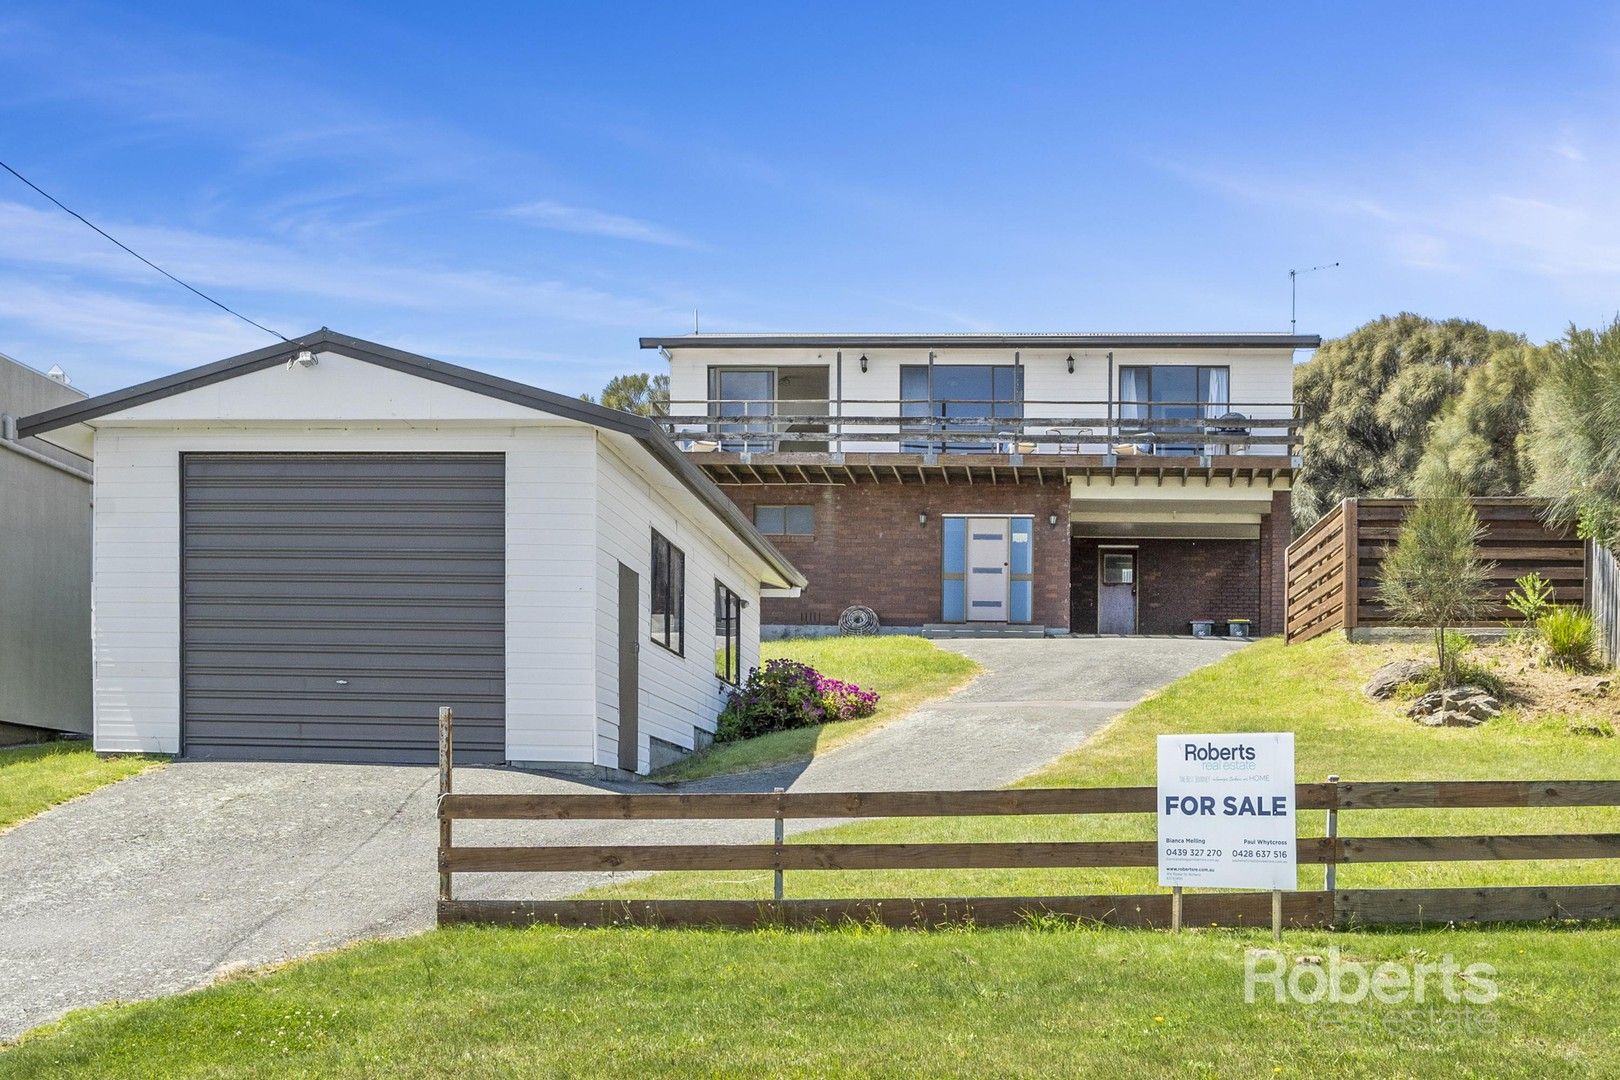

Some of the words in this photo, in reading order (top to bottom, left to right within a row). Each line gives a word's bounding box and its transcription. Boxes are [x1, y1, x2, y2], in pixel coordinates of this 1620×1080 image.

[1184, 742, 1256, 761] Roberts
[1202, 760, 1220, 771] real
[1222, 760, 1257, 771] estate
[1165, 796, 1216, 816] FOR
[1223, 796, 1287, 817] SALE
[1165, 848, 1188, 857] 0439
[1189, 848, 1205, 857] 327
[1206, 849, 1223, 857] 270
[1231, 849, 1254, 858] 0428
[1255, 850, 1271, 858] 637
[1273, 850, 1288, 859] 516
